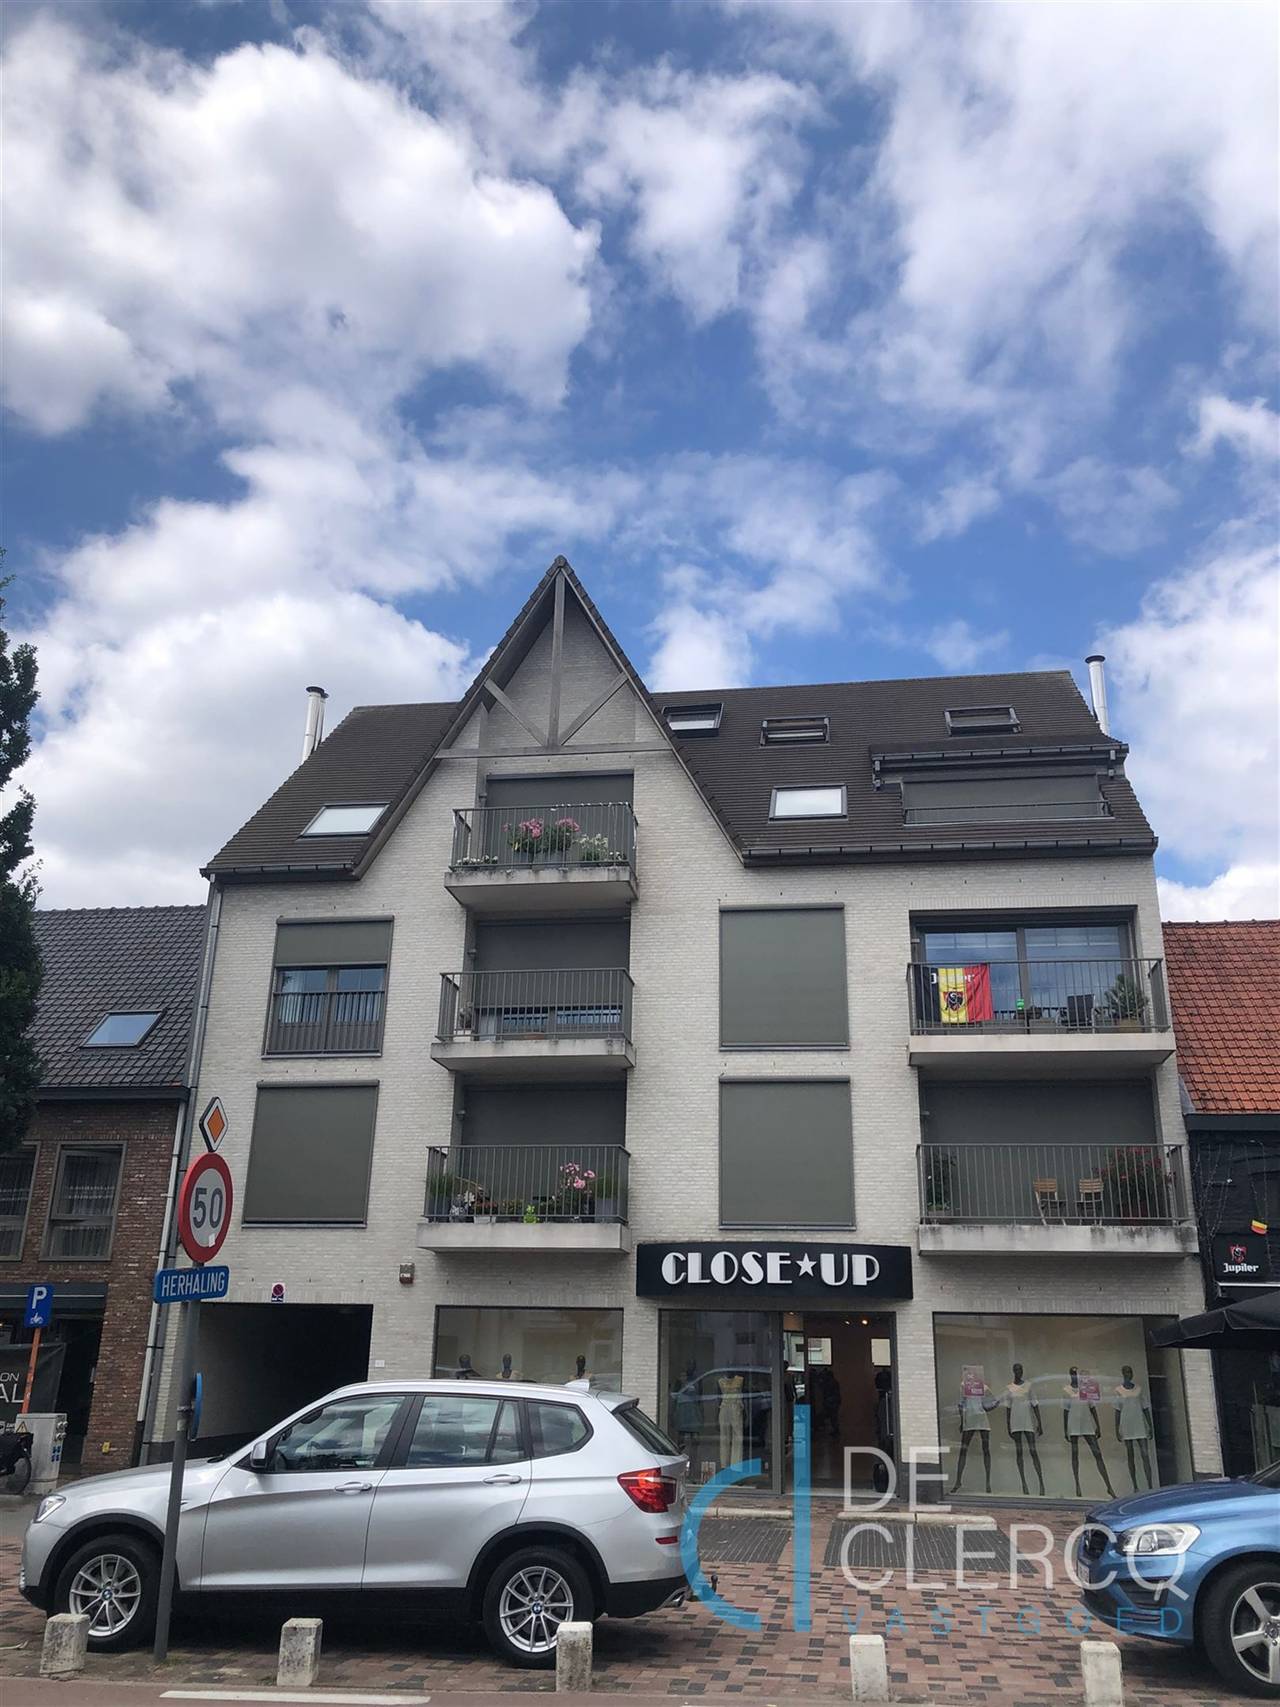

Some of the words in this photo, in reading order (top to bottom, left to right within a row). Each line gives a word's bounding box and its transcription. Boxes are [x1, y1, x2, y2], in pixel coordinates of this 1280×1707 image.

[192, 1187, 223, 1229] 50
[661, 1251, 793, 1285] CLOSE
[820, 1252, 880, 1286] UP
[1223, 1262, 1259, 1274] Jupiler
[31, 1286, 47, 1310] P
[161, 1271, 226, 1298] HERHALING
